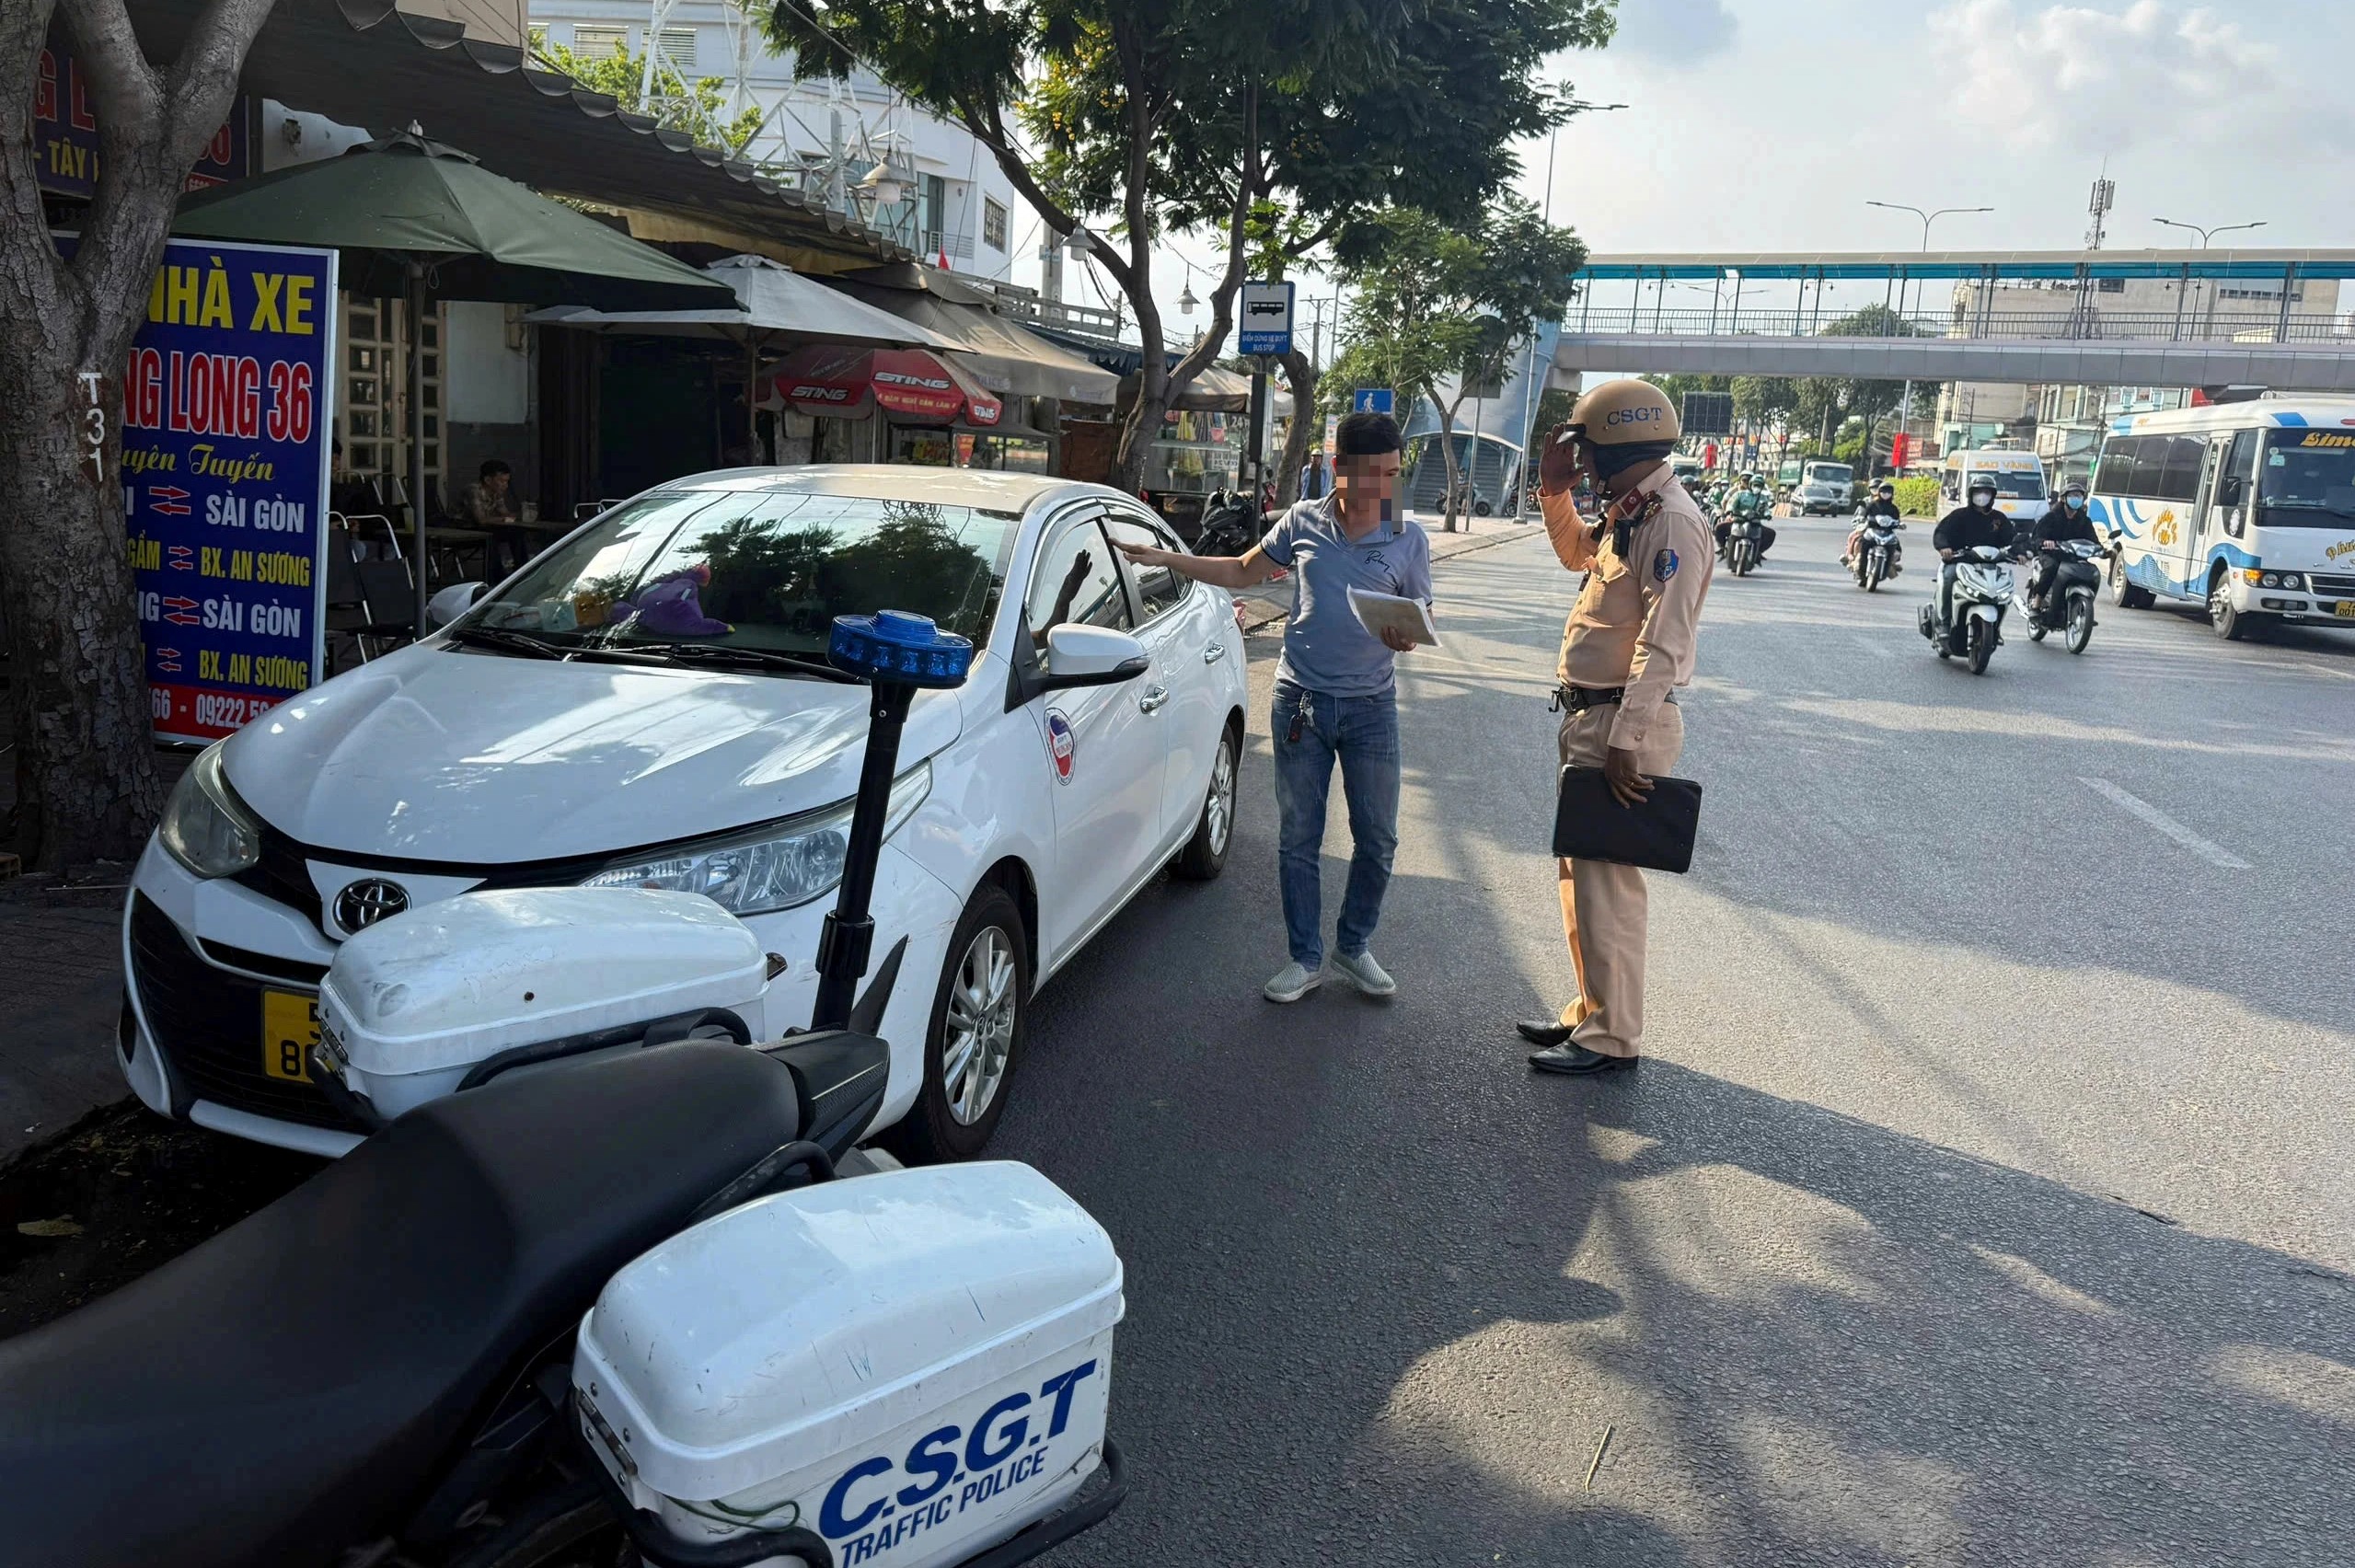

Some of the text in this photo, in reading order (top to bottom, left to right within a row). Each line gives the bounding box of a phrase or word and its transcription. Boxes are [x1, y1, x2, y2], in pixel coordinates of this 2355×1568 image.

[249, 272, 314, 335] XE
[122, 348, 312, 444] NG LONG 36
[791, 386, 848, 401] STING
[874, 372, 950, 390] STING
[1607, 408, 1662, 425] CSGT
[189, 444, 274, 483] Tuyến
[206, 490, 305, 533] SÀI GÒN
[200, 547, 225, 578] BX.
[230, 549, 253, 581] AN
[257, 550, 310, 586] SƯƠNG
[202, 594, 242, 631] SÀI
[250, 599, 301, 638] GÒN
[199, 650, 308, 690] BX. AN SƯƠNG
[149, 689, 170, 720] 66
[195, 694, 244, 727] 09222
[819, 1358, 1097, 1539] C.S.G.T
[841, 1447, 1048, 1568] TRAFFIC POLICE
